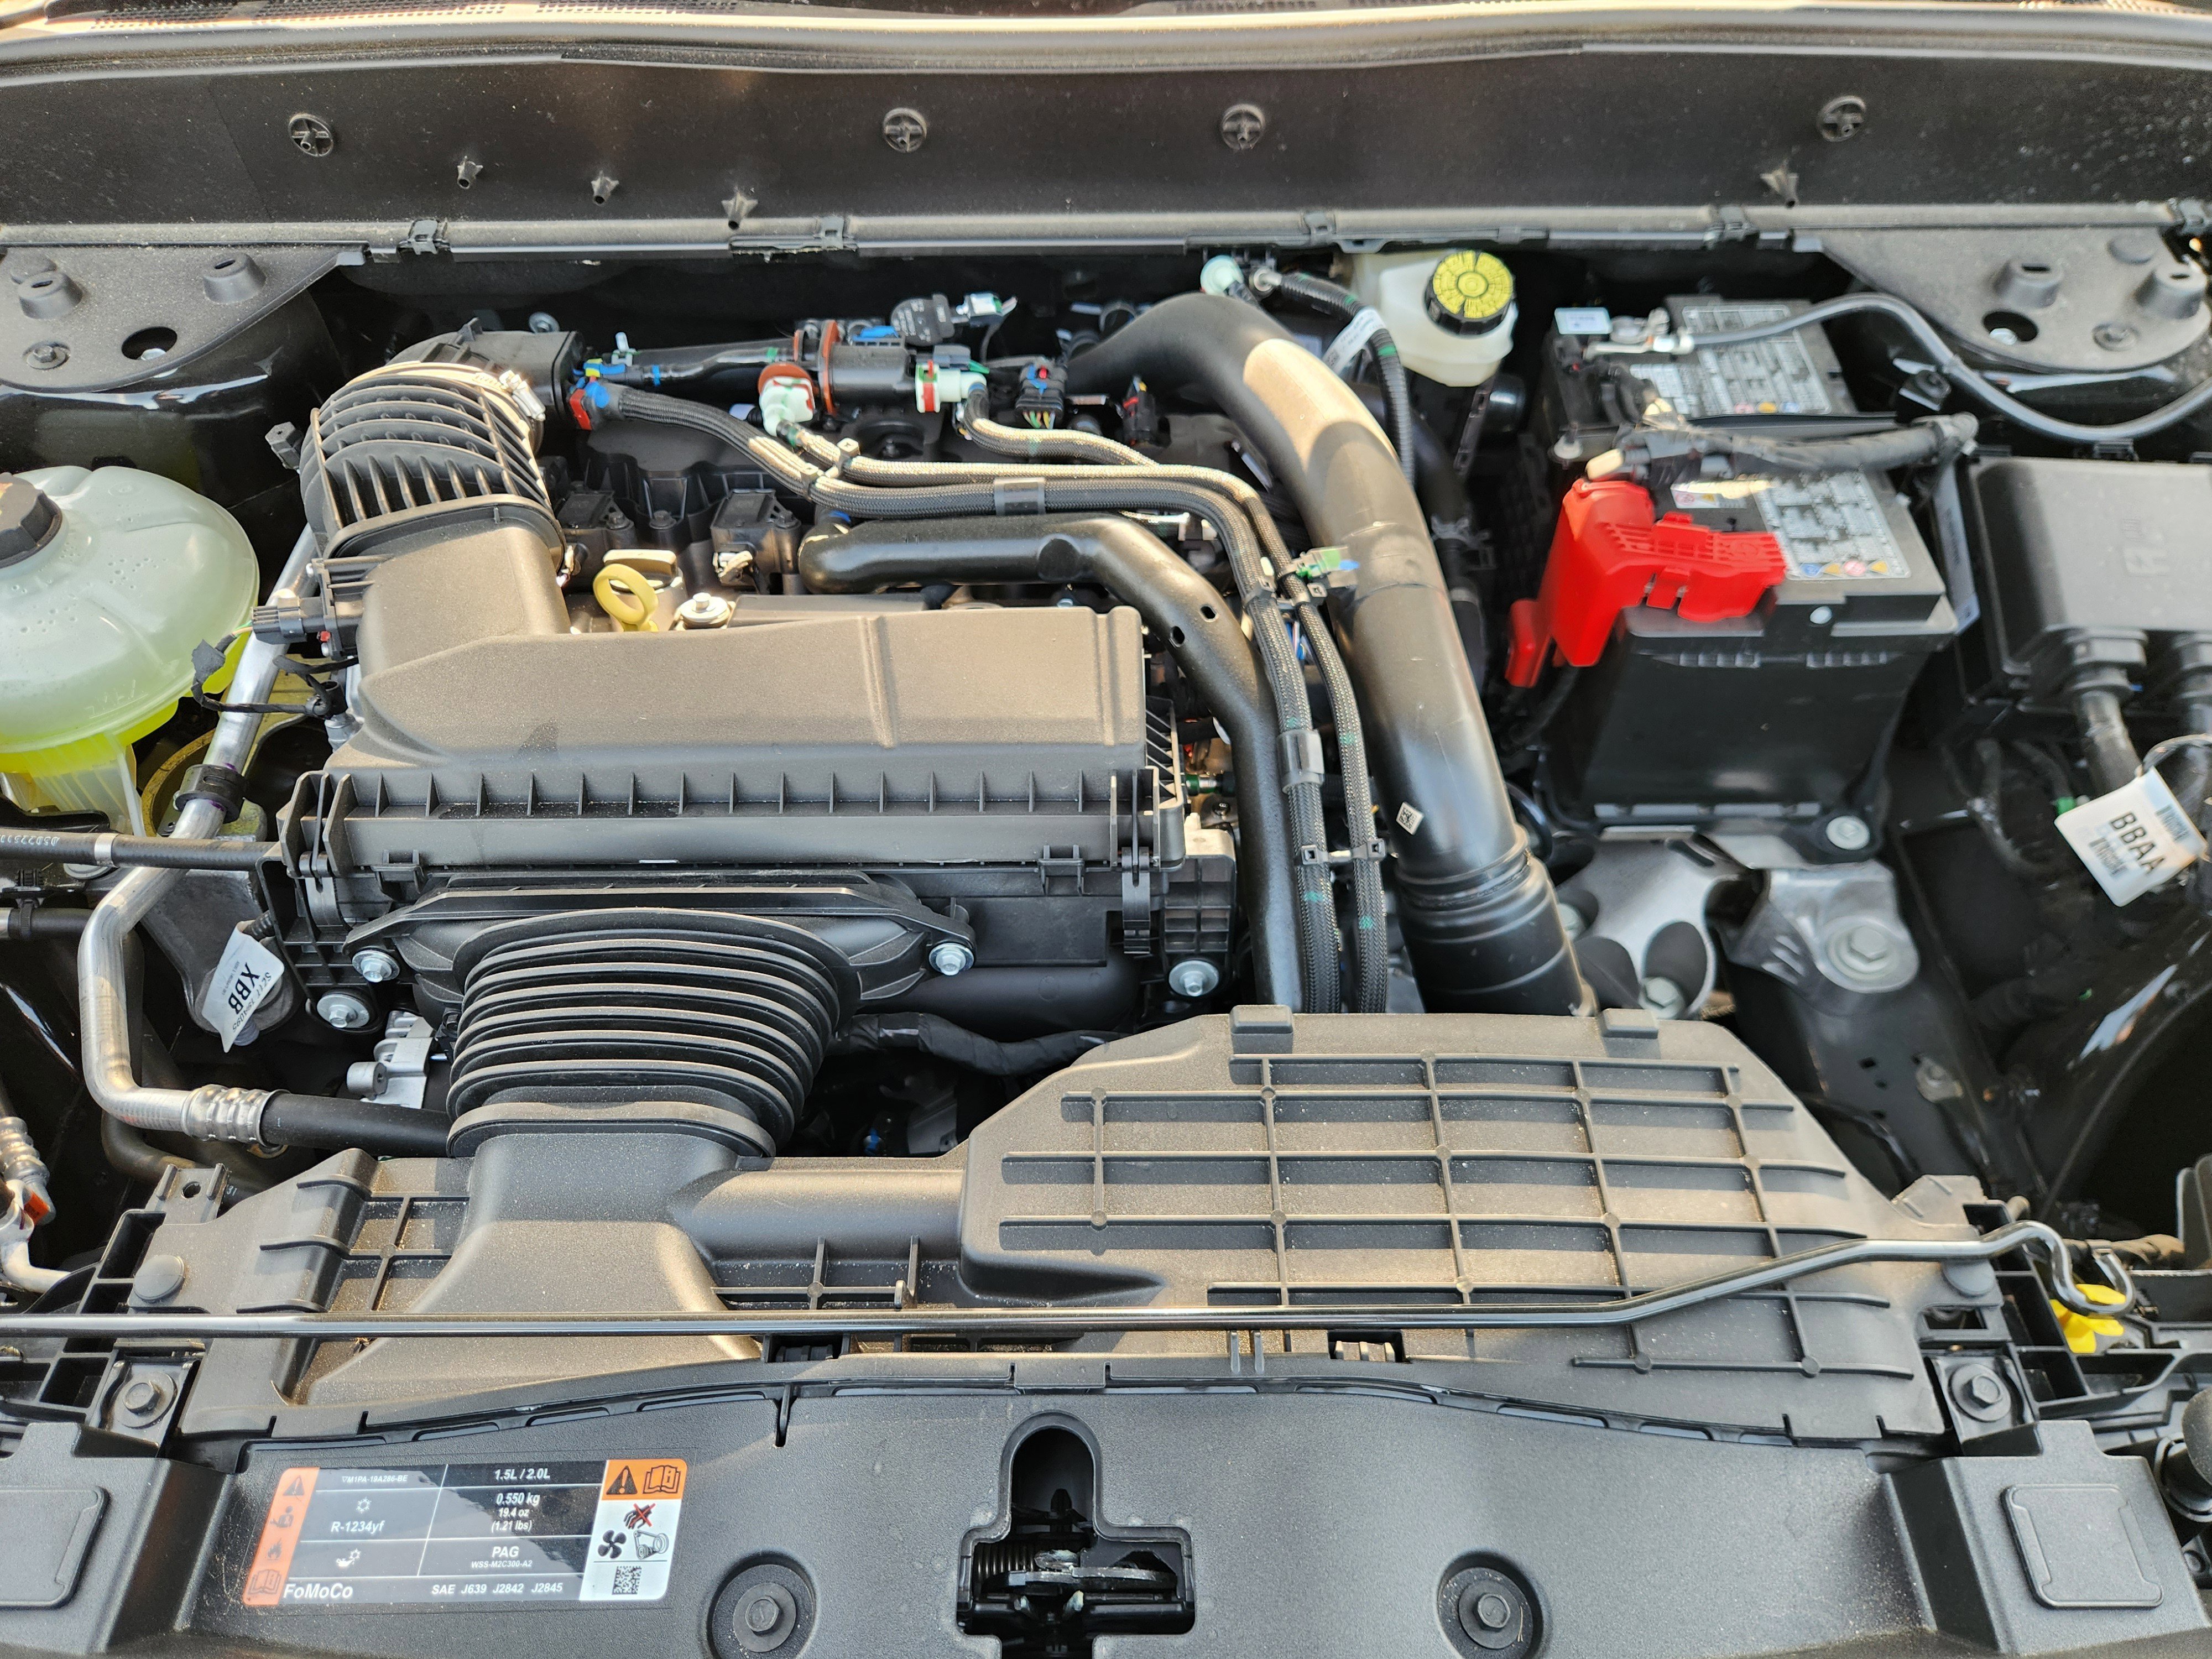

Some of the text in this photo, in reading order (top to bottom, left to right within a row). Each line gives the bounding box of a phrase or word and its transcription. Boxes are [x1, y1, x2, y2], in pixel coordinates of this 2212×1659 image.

[2109, 811, 2166, 874] BBAA
[228, 962, 260, 1015] XBB
[494, 1469, 518, 1480] 1.5L
[526, 1468, 551, 1480] 2.0L
[496, 1492, 540, 1507] 0.550 kg
[498, 1507, 530, 1517] 19.4 oz
[331, 1520, 385, 1535] R-1234yf
[491, 1520, 533, 1533] (1.21 lbs)
[492, 1546, 520, 1558] PAG
[471, 1560, 533, 1568] WSS-M2C300-A2
[283, 1583, 354, 1599] FoMoCo
[431, 1582, 564, 1595] SAE J639 J2842 J2845
